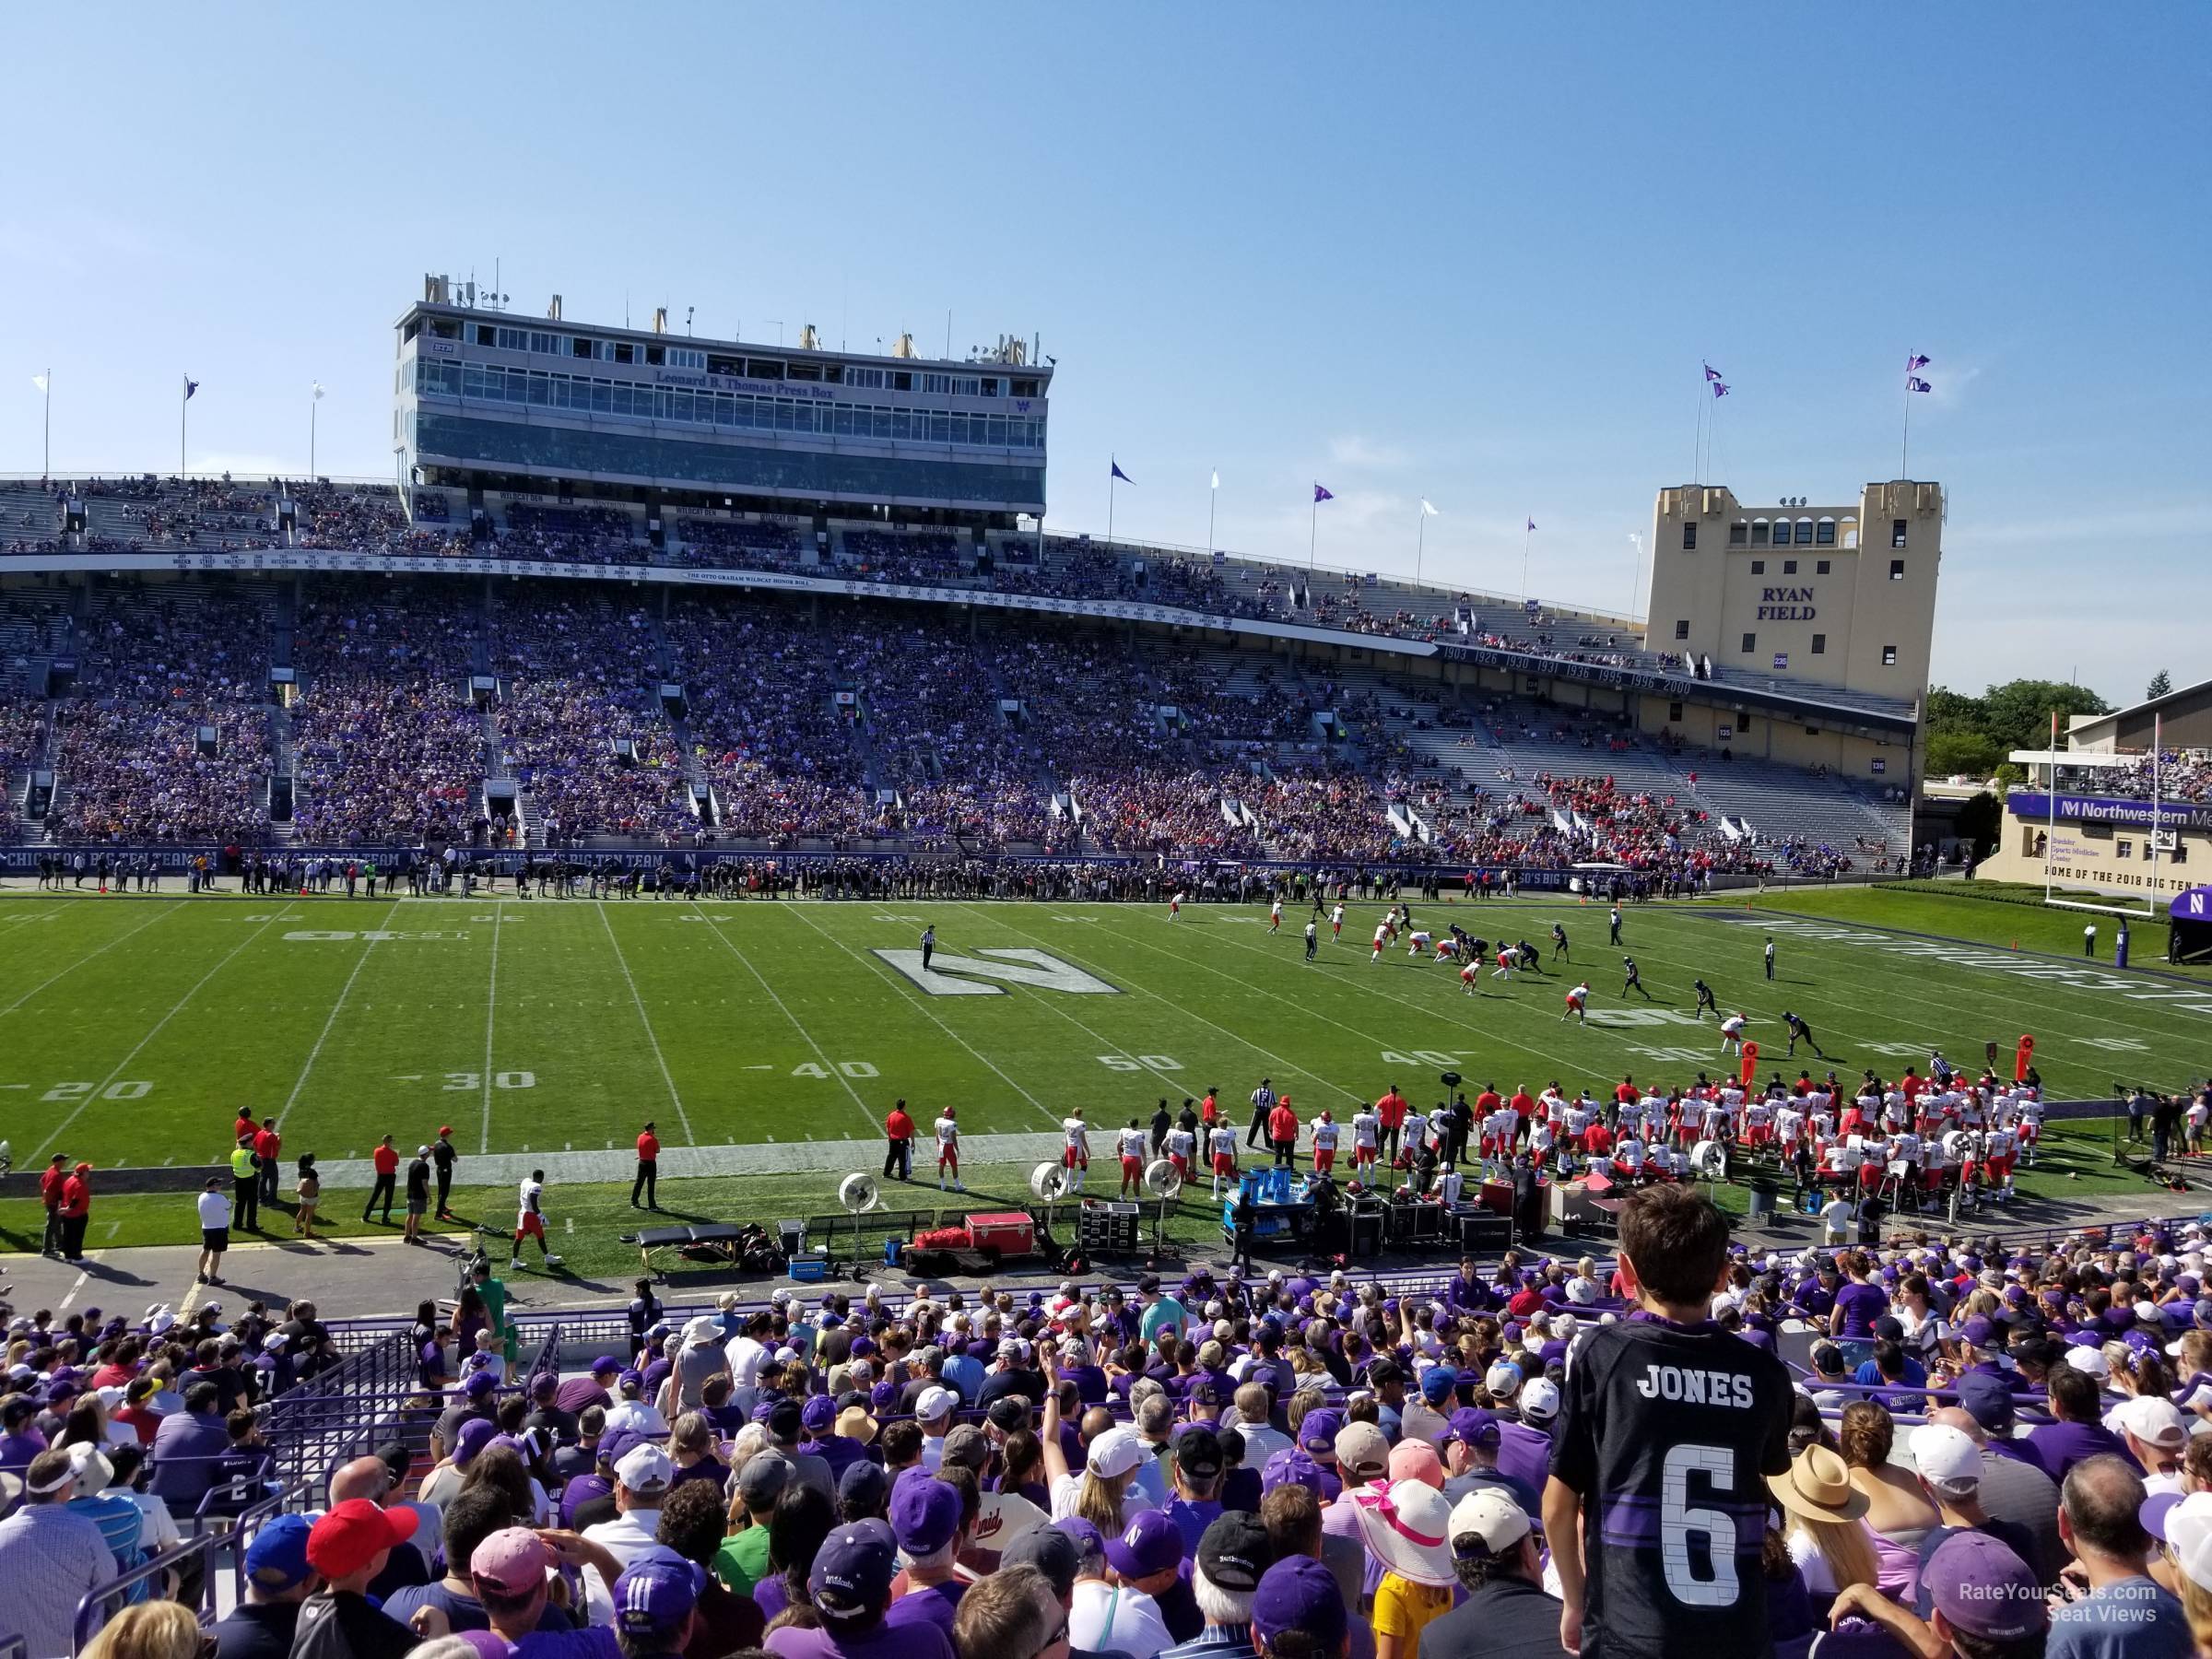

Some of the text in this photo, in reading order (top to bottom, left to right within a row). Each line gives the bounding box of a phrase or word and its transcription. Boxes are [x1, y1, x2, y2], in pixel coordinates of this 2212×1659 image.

[655, 371, 834, 399] Leonard B. Thomas Press Box
[500, 491, 543, 502] WILDCAT DEN
[677, 507, 716, 517] WILDCAT DEN
[759, 513, 798, 524] WILDCAT DEN
[922, 524, 959, 534] WILDCAT DEN
[1762, 588, 1814, 602] RYAN
[1757, 606, 1816, 620] FIELD
[1443, 647, 1691, 694] 1903 1926 1930 1931 1936 1995 1996 2000
[2081, 802, 2187, 825] Northwestern
[2156, 830, 2173, 845] 24
[2052, 846, 2100, 857] Sports Medicine
[2052, 854, 2071, 863] Center
[90, 853, 115, 866] BG
[570, 854, 592, 867] BIG
[627, 854, 664, 867] TEAM
[685, 853, 697, 869] N
[1542, 873, 1560, 885] BIG
[2076, 869, 2088, 879] OF
[2092, 871, 2112, 882] THE
[2116, 874, 2142, 887] 2018
[2147, 877, 2165, 888] BIG
[2171, 880, 2193, 891] TEN
[2190, 893, 2204, 914] N
[1381, 1050, 1463, 1065] 40
[1625, 1047, 1716, 1062] 30
[791, 1062, 881, 1079] 40
[1096, 1055, 1185, 1071] 50
[442, 1071, 536, 1090] 30
[40, 1081, 154, 1101] 20
[1260, 1092, 1267, 1105] F
[1503, 1115, 1512, 1127] 7
[1635, 1364, 1754, 1408] JONES
[1661, 1443, 1740, 1606] 6
[1124, 1524, 1143, 1548] N
[825, 1575, 854, 1590] Wildcats
